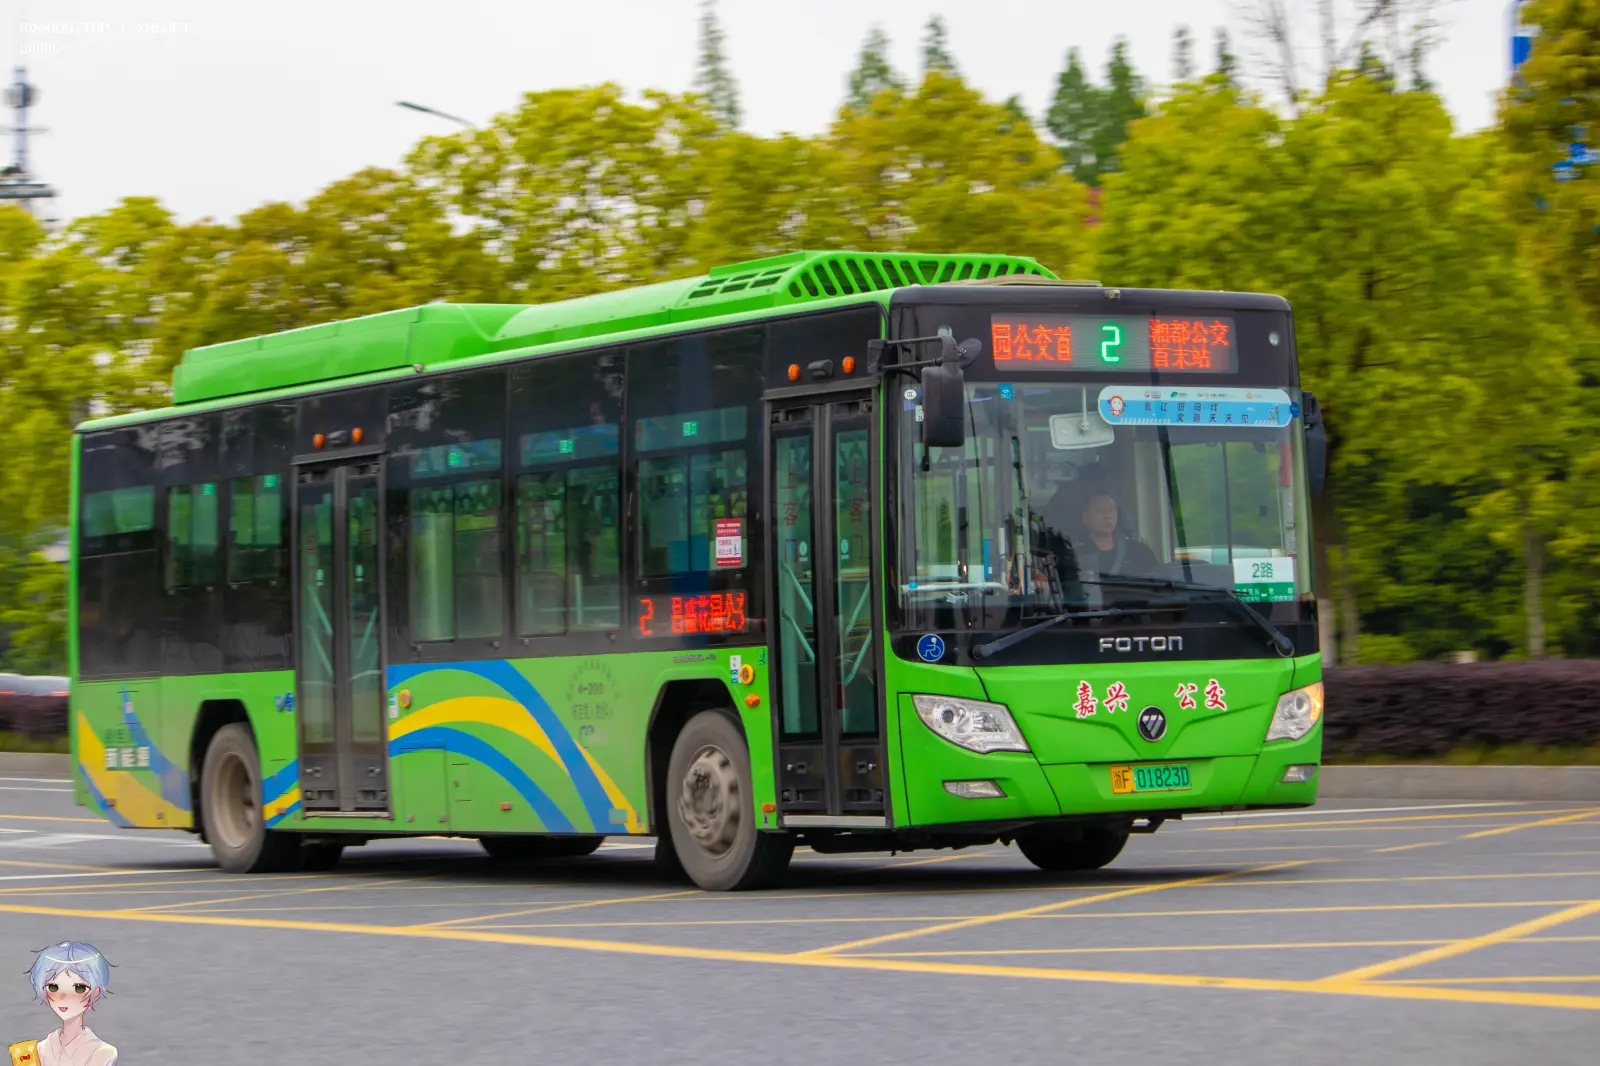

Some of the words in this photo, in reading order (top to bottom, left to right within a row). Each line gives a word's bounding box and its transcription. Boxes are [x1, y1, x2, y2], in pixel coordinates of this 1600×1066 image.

[1101, 325, 1121, 362] 2
[1252, 562, 1273, 578] 2路
[640, 598, 653, 635] 2
[1099, 636, 1183, 652] FOTON
[1073, 680, 1130, 718] 嘉兴
[1174, 679, 1228, 711] 公交
